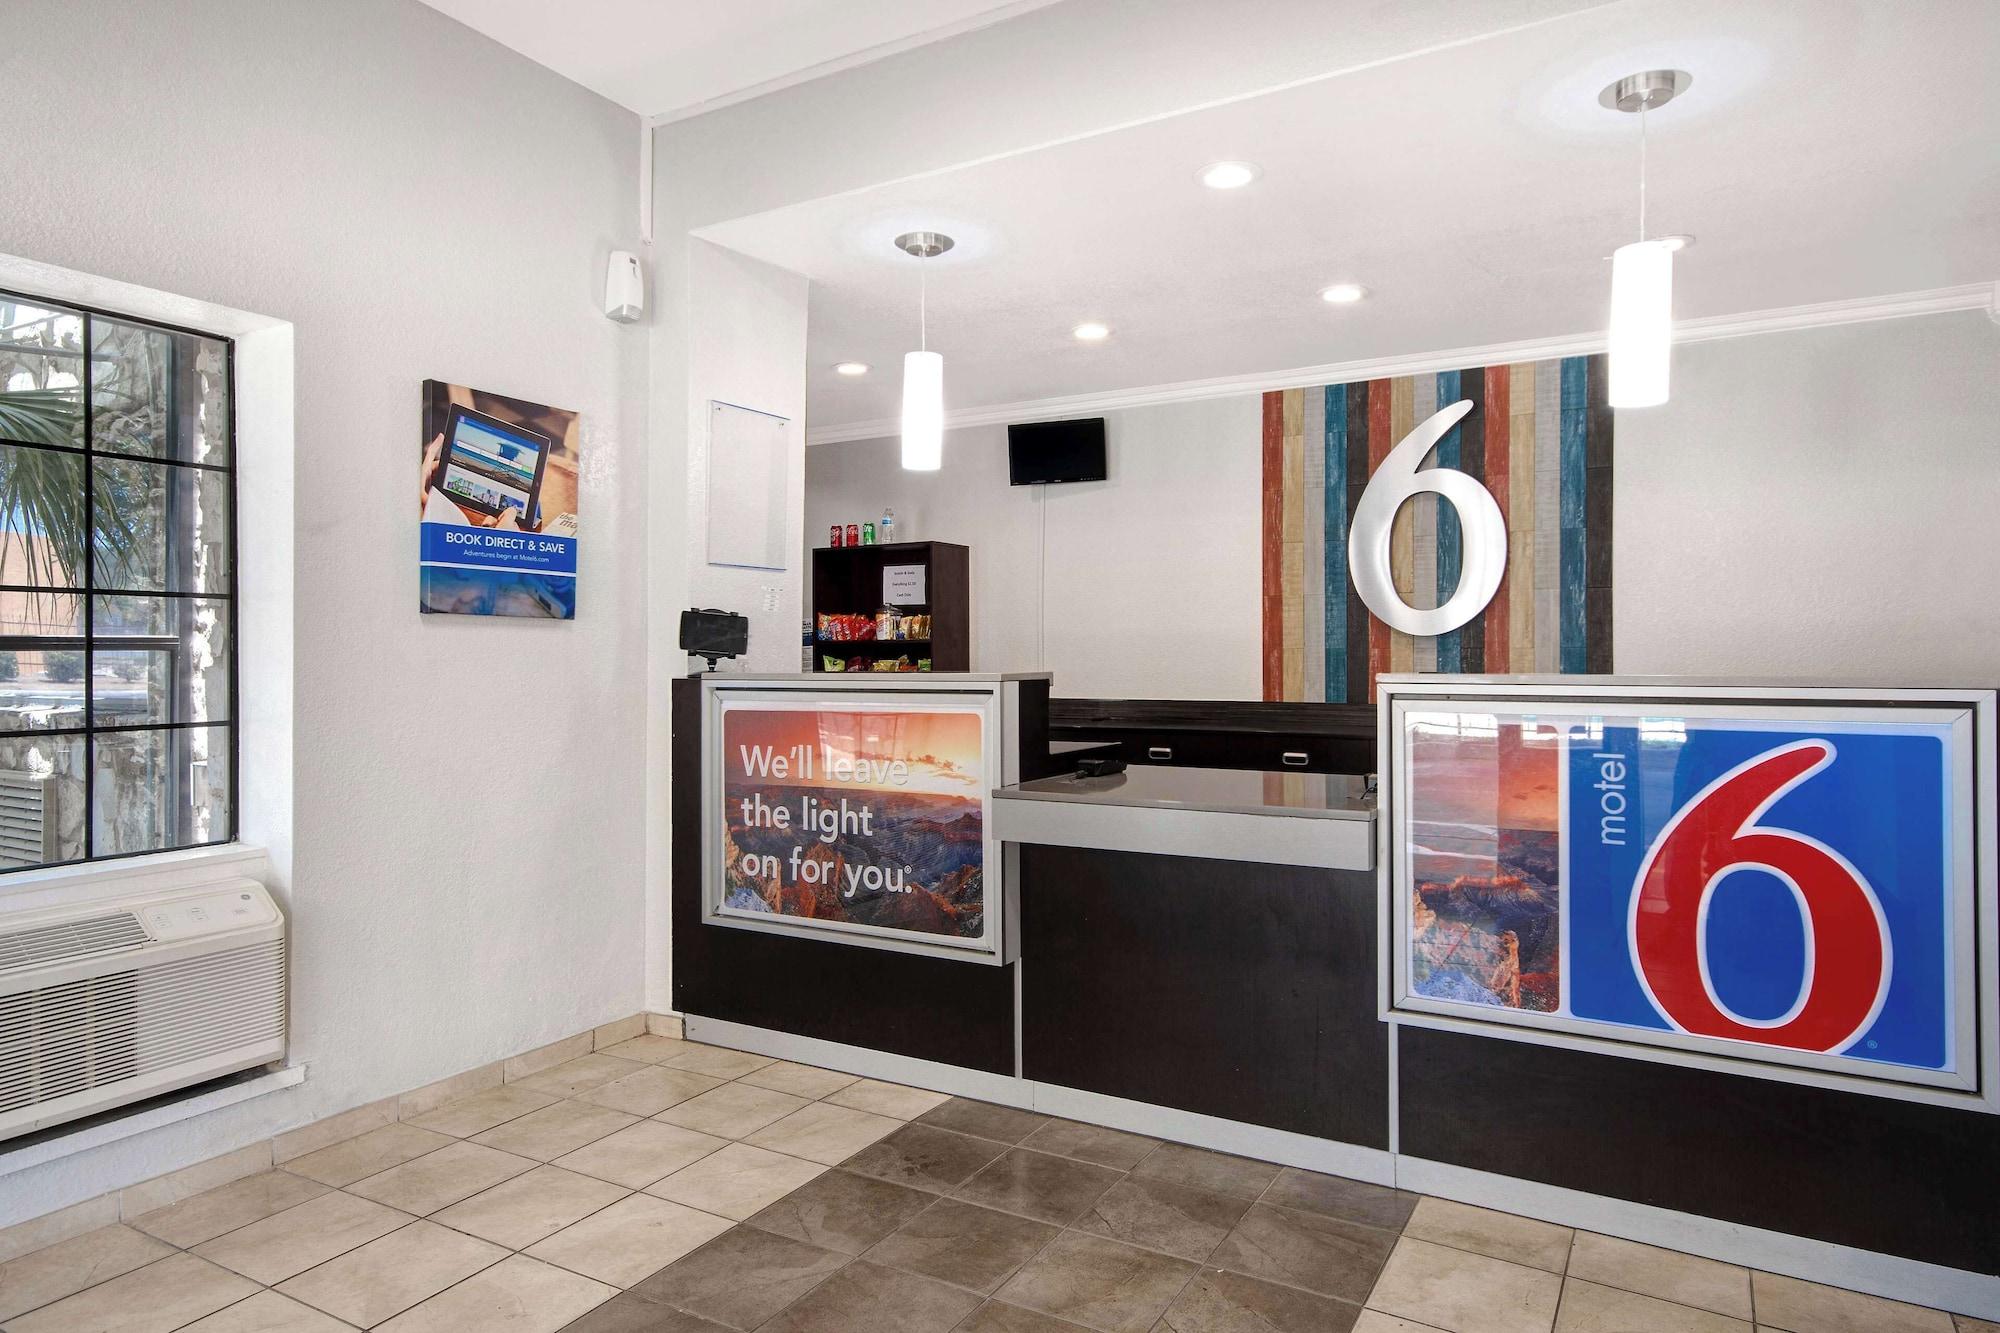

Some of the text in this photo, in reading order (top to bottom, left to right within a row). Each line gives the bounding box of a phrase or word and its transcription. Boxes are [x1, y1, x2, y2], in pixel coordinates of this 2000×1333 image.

[1349, 399, 1507, 636] 6
[446, 531, 565, 554] BOOK DIRECT & SAVE
[463, 549, 496, 558] Adventures
[496, 552, 513, 561] begin
[519, 554, 550, 563] Motel6.com
[740, 744, 909, 786] We'll leave
[740, 792, 873, 843] the light
[1592, 752, 1627, 846] motel
[742, 853, 778, 879] on
[789, 846, 834, 885] for
[1627, 738, 1893, 1055] 6
